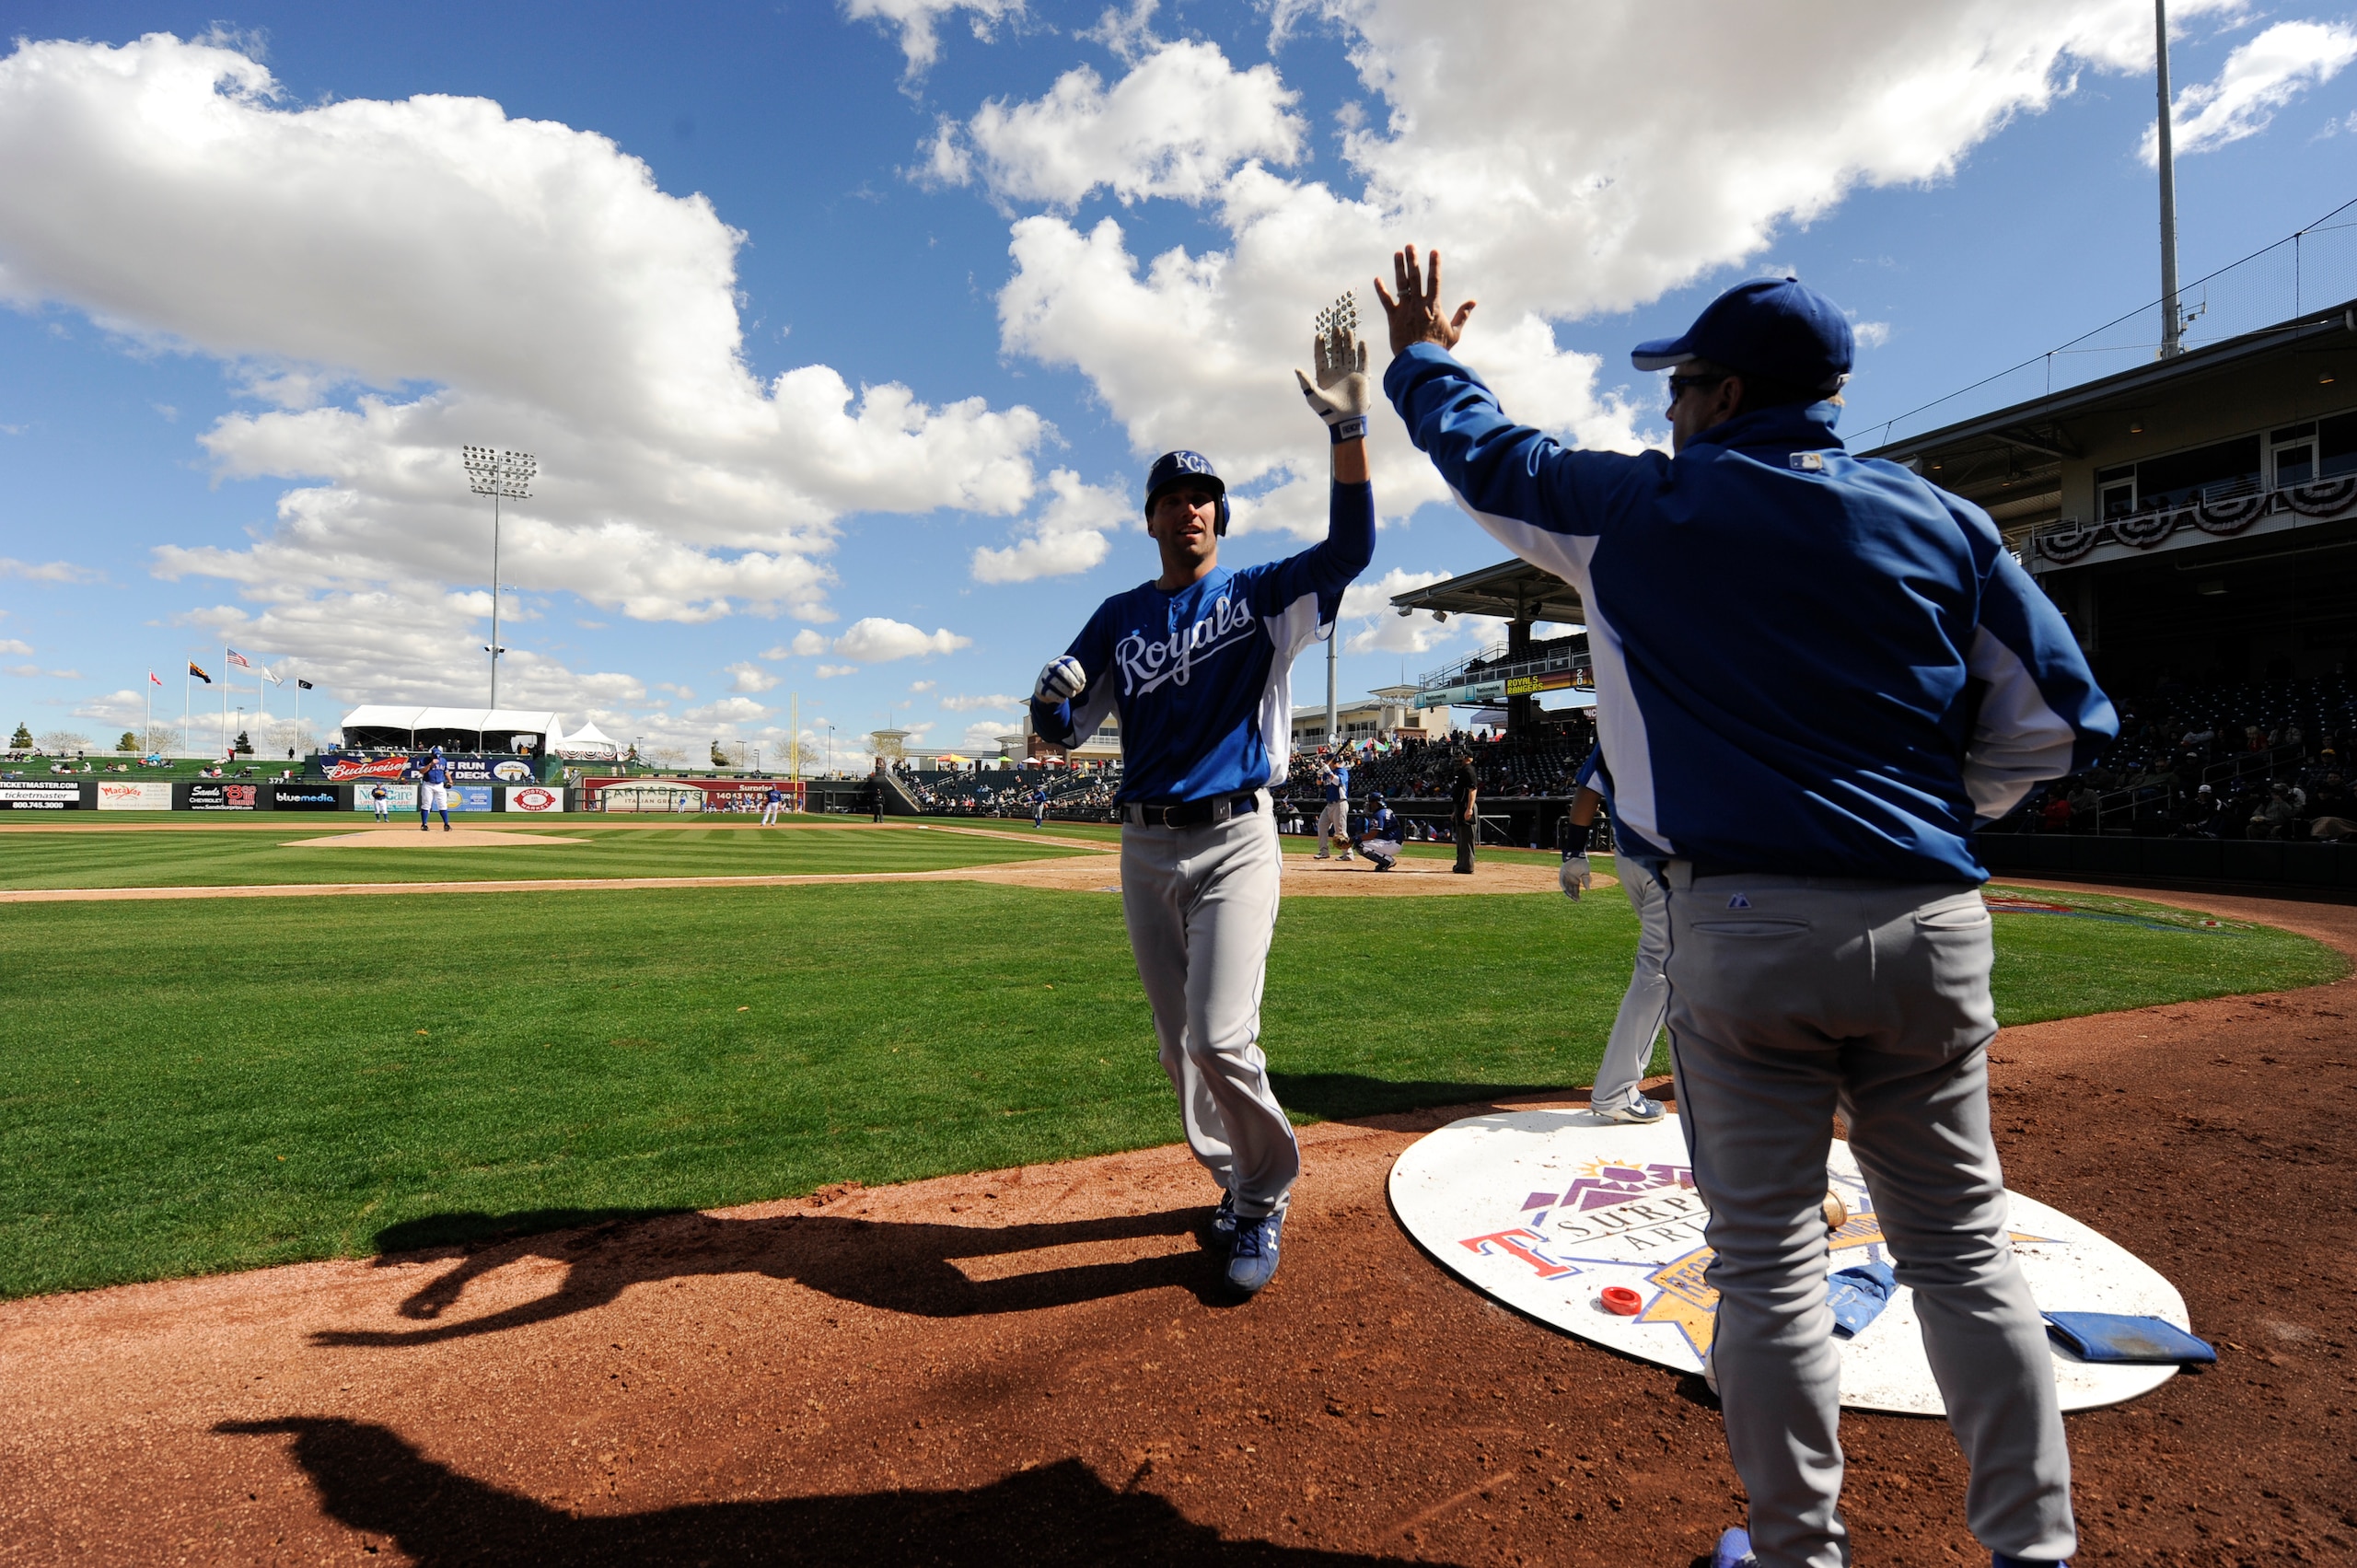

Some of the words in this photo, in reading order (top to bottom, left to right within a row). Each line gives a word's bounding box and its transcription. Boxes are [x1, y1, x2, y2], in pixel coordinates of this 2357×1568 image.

[1115, 596, 1256, 698] Royals
[1506, 676, 1538, 688] ROYALS
[1576, 668, 1584, 677] 2
[1506, 683, 1544, 695] RANGERS
[1576, 677, 1584, 685] 0
[321, 761, 412, 779] Budweiser
[458, 761, 485, 770] RUN
[455, 772, 492, 780] DECK
[0, 781, 78, 789] TICKETMASTER.COM
[191, 785, 221, 796] Sands
[521, 789, 550, 797] BOSTON
[275, 792, 333, 803] bluemedia
[12, 801, 64, 809] 800.745.3000
[521, 801, 551, 810] MARKET
